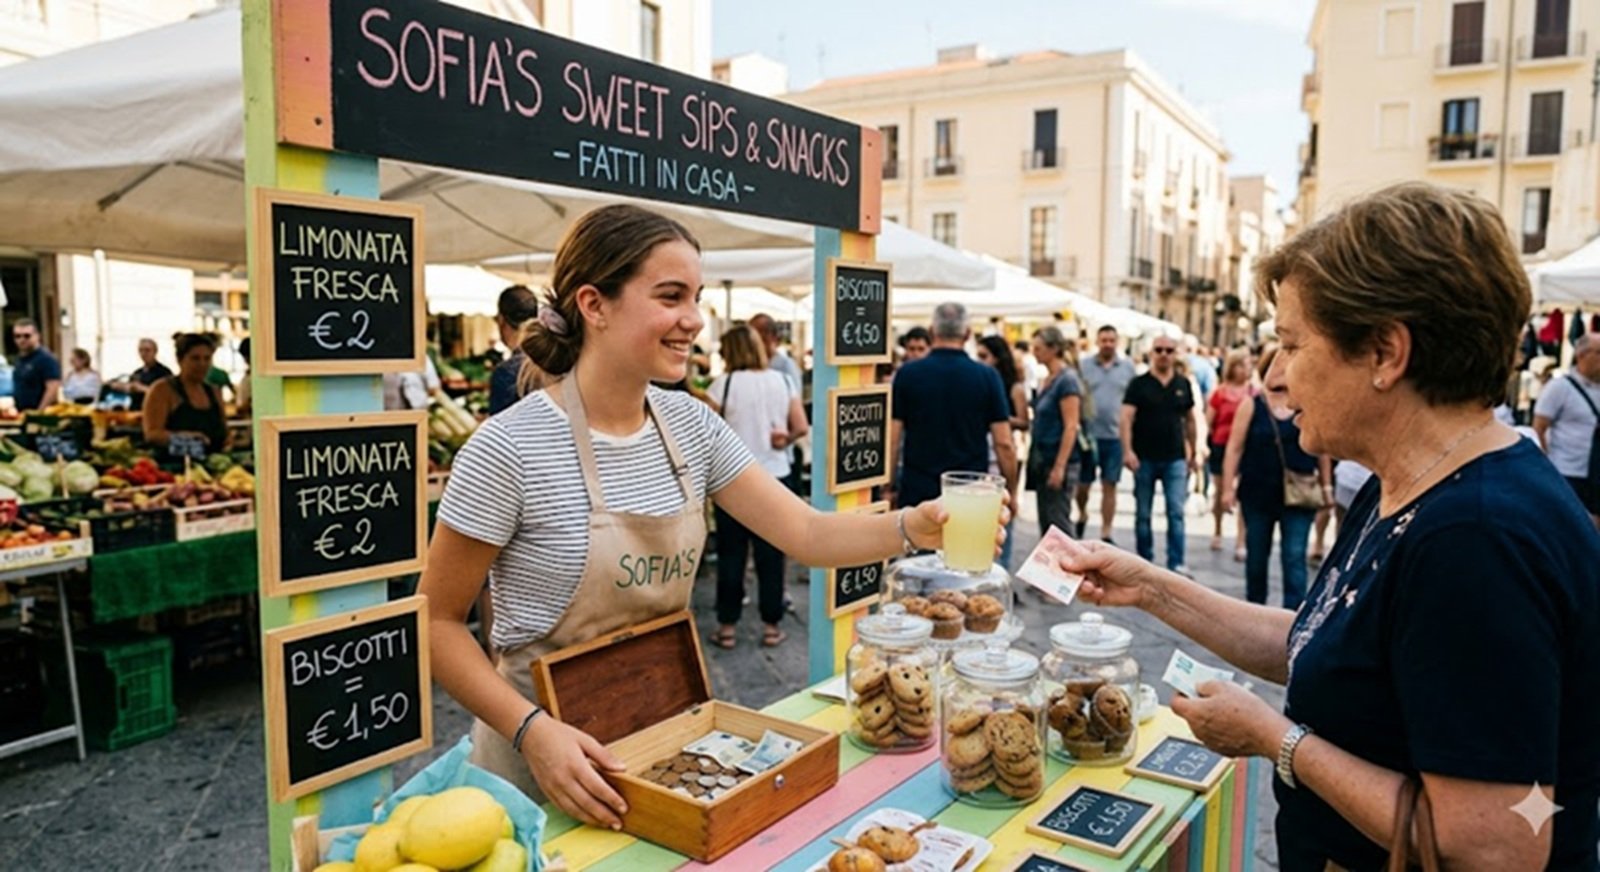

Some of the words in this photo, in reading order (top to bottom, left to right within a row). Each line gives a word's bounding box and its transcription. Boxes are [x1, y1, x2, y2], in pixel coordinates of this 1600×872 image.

[357, 7, 544, 117] SOFIA'S
[562, 61, 671, 140] SWEET
[745, 128, 761, 162] &
[766, 117, 851, 188] SNACKS
[578, 140, 647, 188] FATTI
[657, 158, 677, 191] IN
[684, 162, 740, 203] CASA
[280, 221, 408, 265] LIMONATA
[291, 266, 399, 304] FRESCA
[837, 275, 884, 302] BISCOTTI
[839, 402, 883, 426] BISCOTTI
[286, 441, 412, 480] LIMONATA
[296, 480, 399, 519] FRESCA
[616, 548, 695, 588] SOFIA'S
[290, 628, 407, 685] BISCOTTI
[1046, 791, 1101, 831] BISCOTTI
